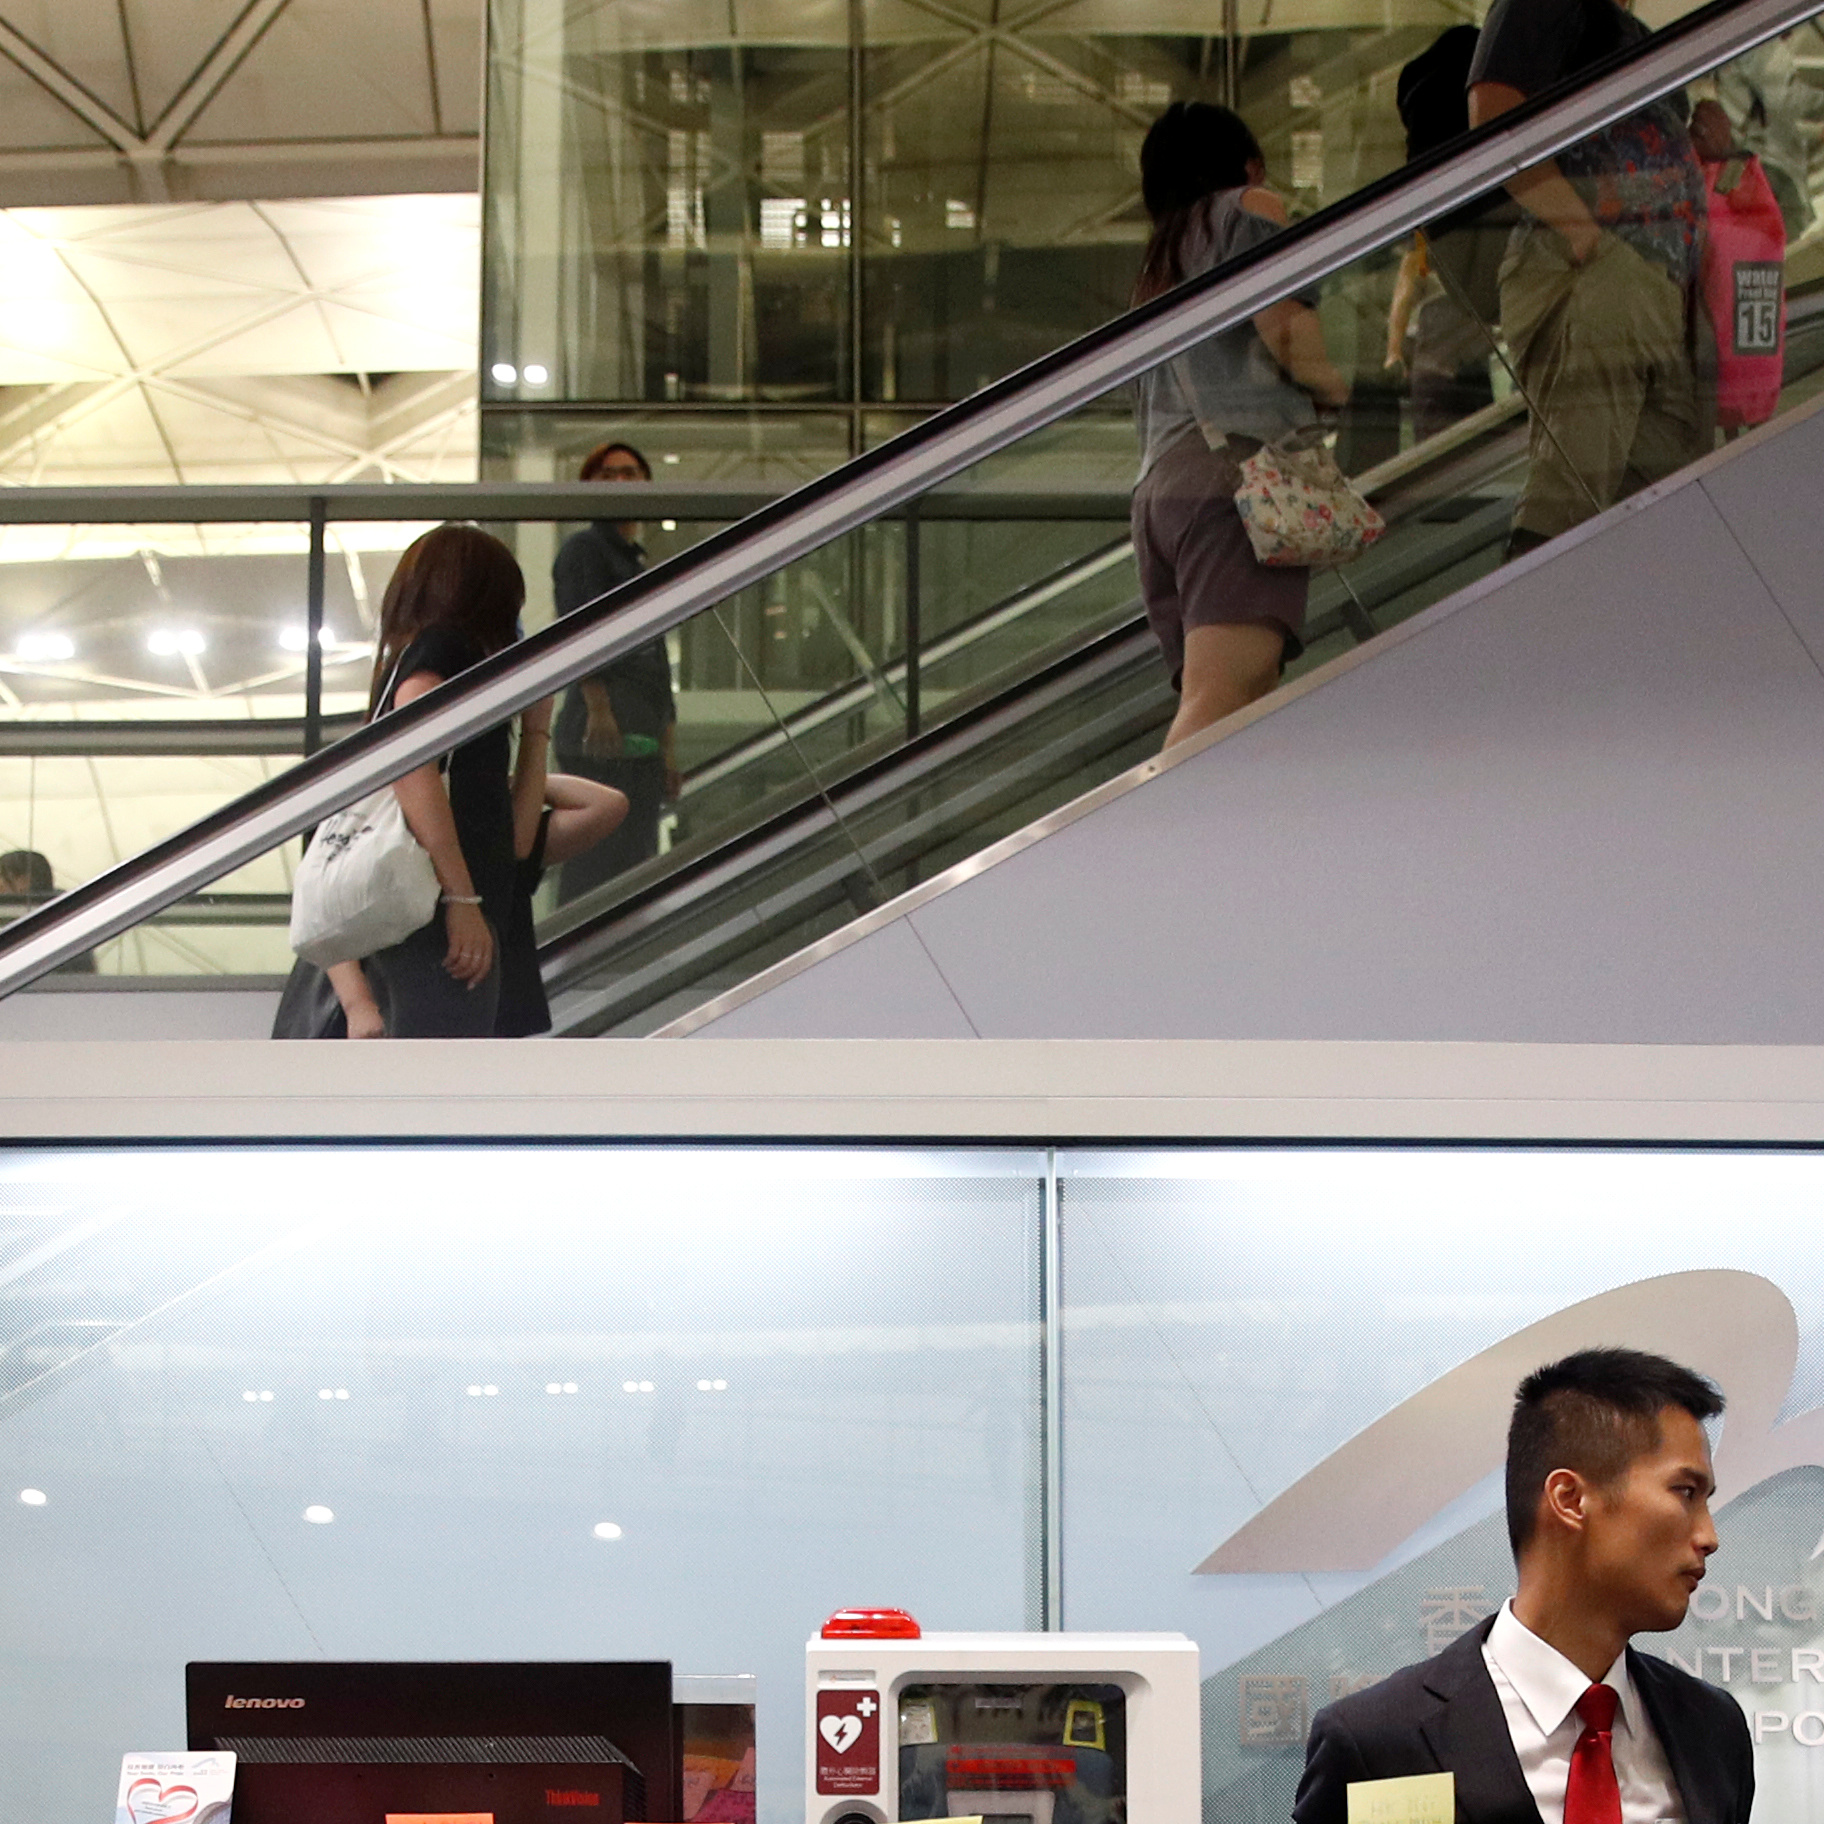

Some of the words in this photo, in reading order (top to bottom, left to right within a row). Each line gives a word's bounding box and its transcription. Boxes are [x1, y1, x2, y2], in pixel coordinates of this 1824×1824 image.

[1742, 305, 1772, 342] 15
[1689, 1585, 1819, 1622] ONG
[224, 1694, 306, 1710] lenovo
